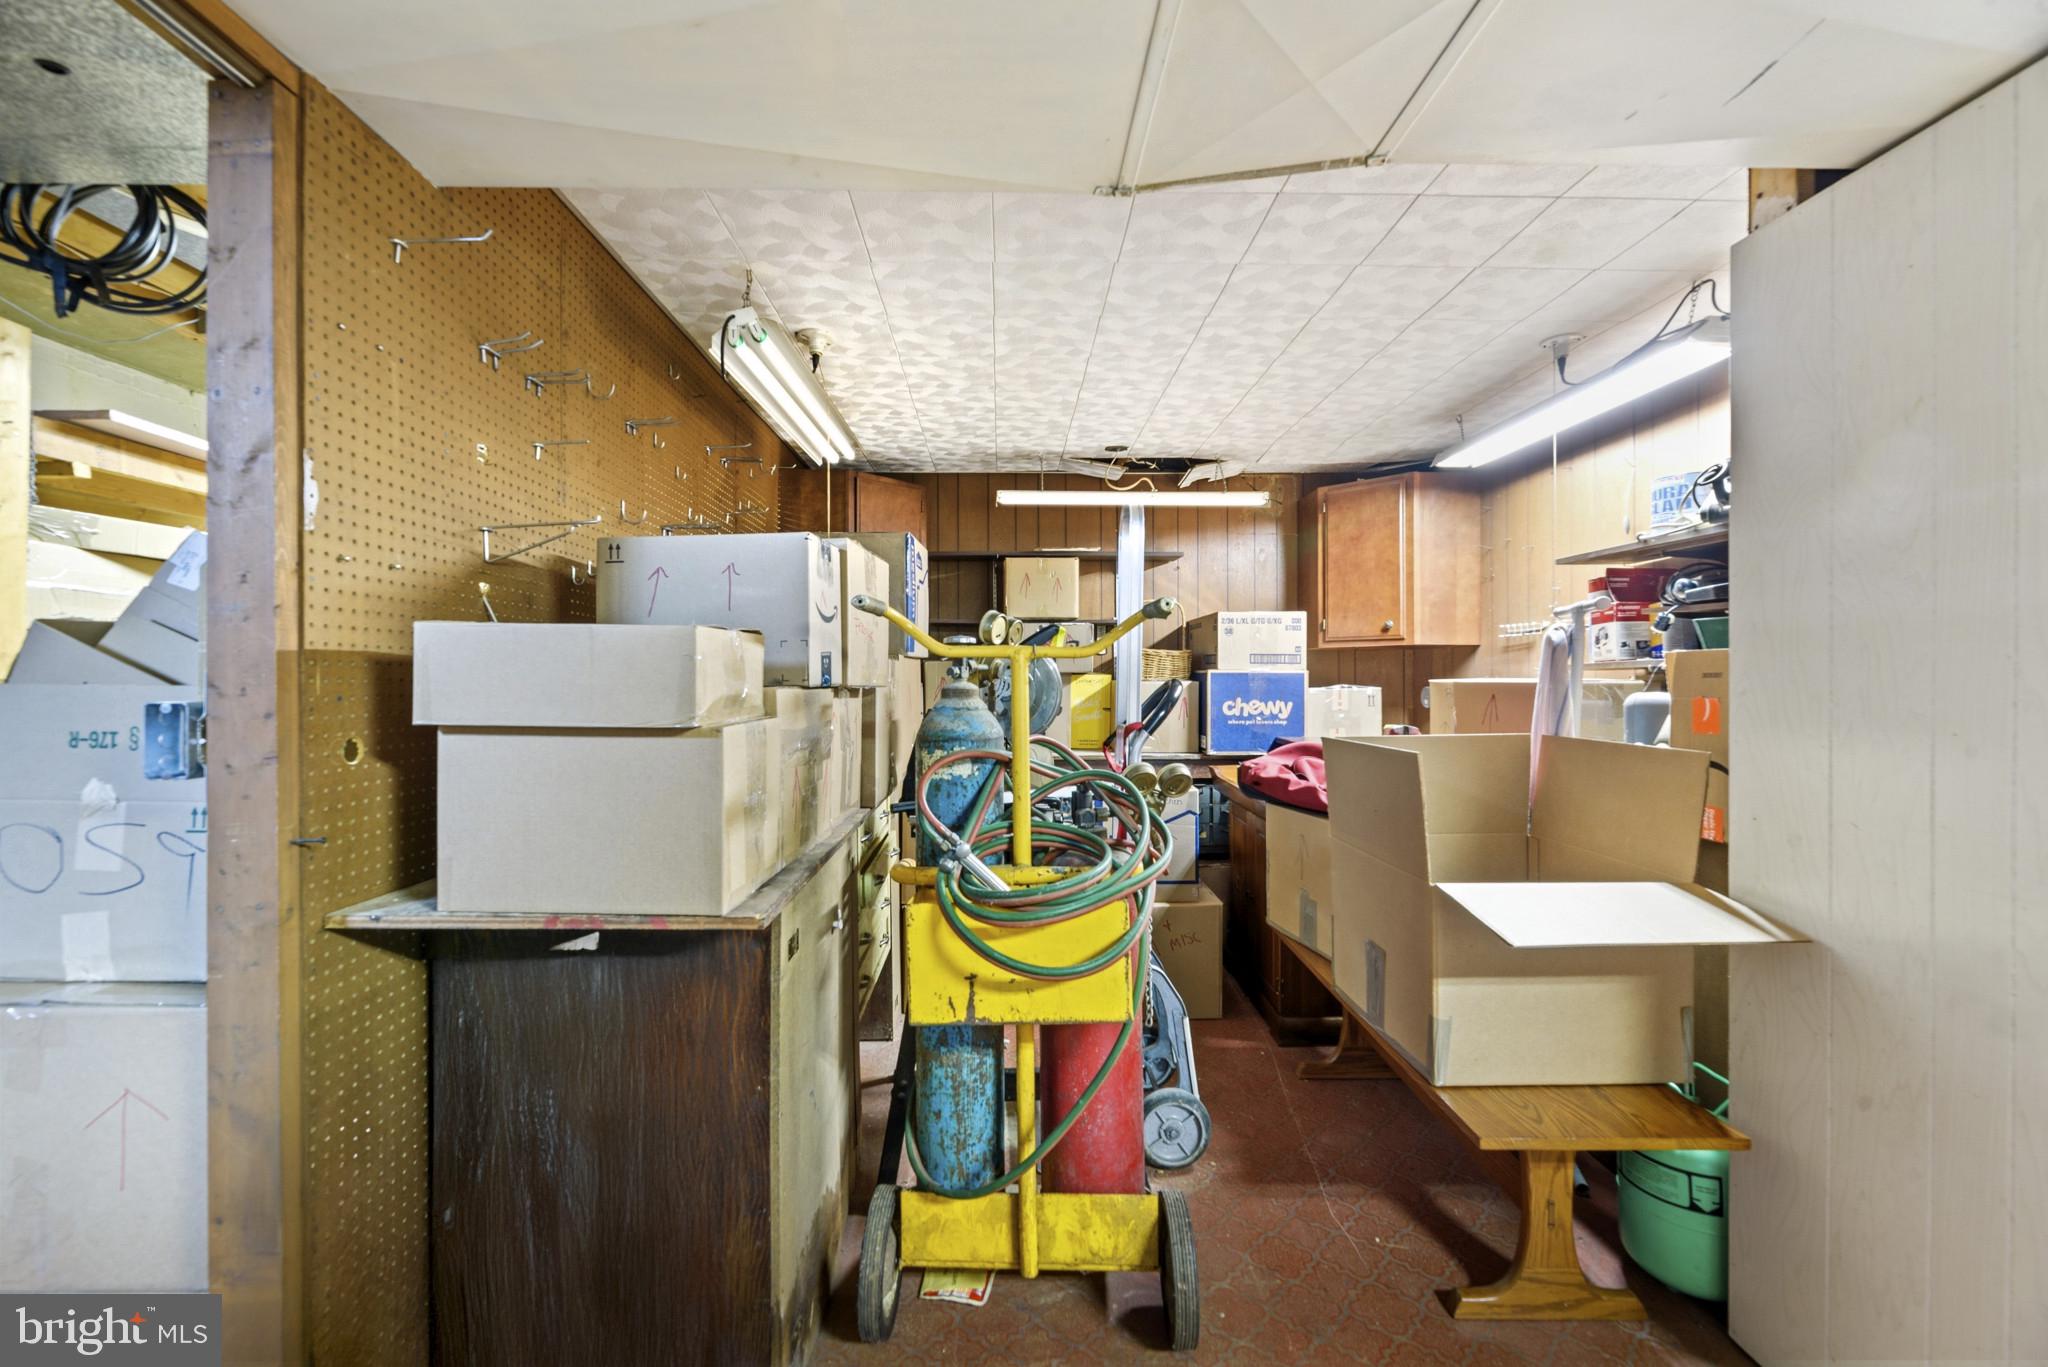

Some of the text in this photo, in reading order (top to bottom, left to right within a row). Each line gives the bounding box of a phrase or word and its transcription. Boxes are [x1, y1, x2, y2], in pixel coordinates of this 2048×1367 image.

[1222, 696, 1293, 719] chewy
[1273, 718, 1288, 727] shop
[69, 731, 119, 749] 176-R
